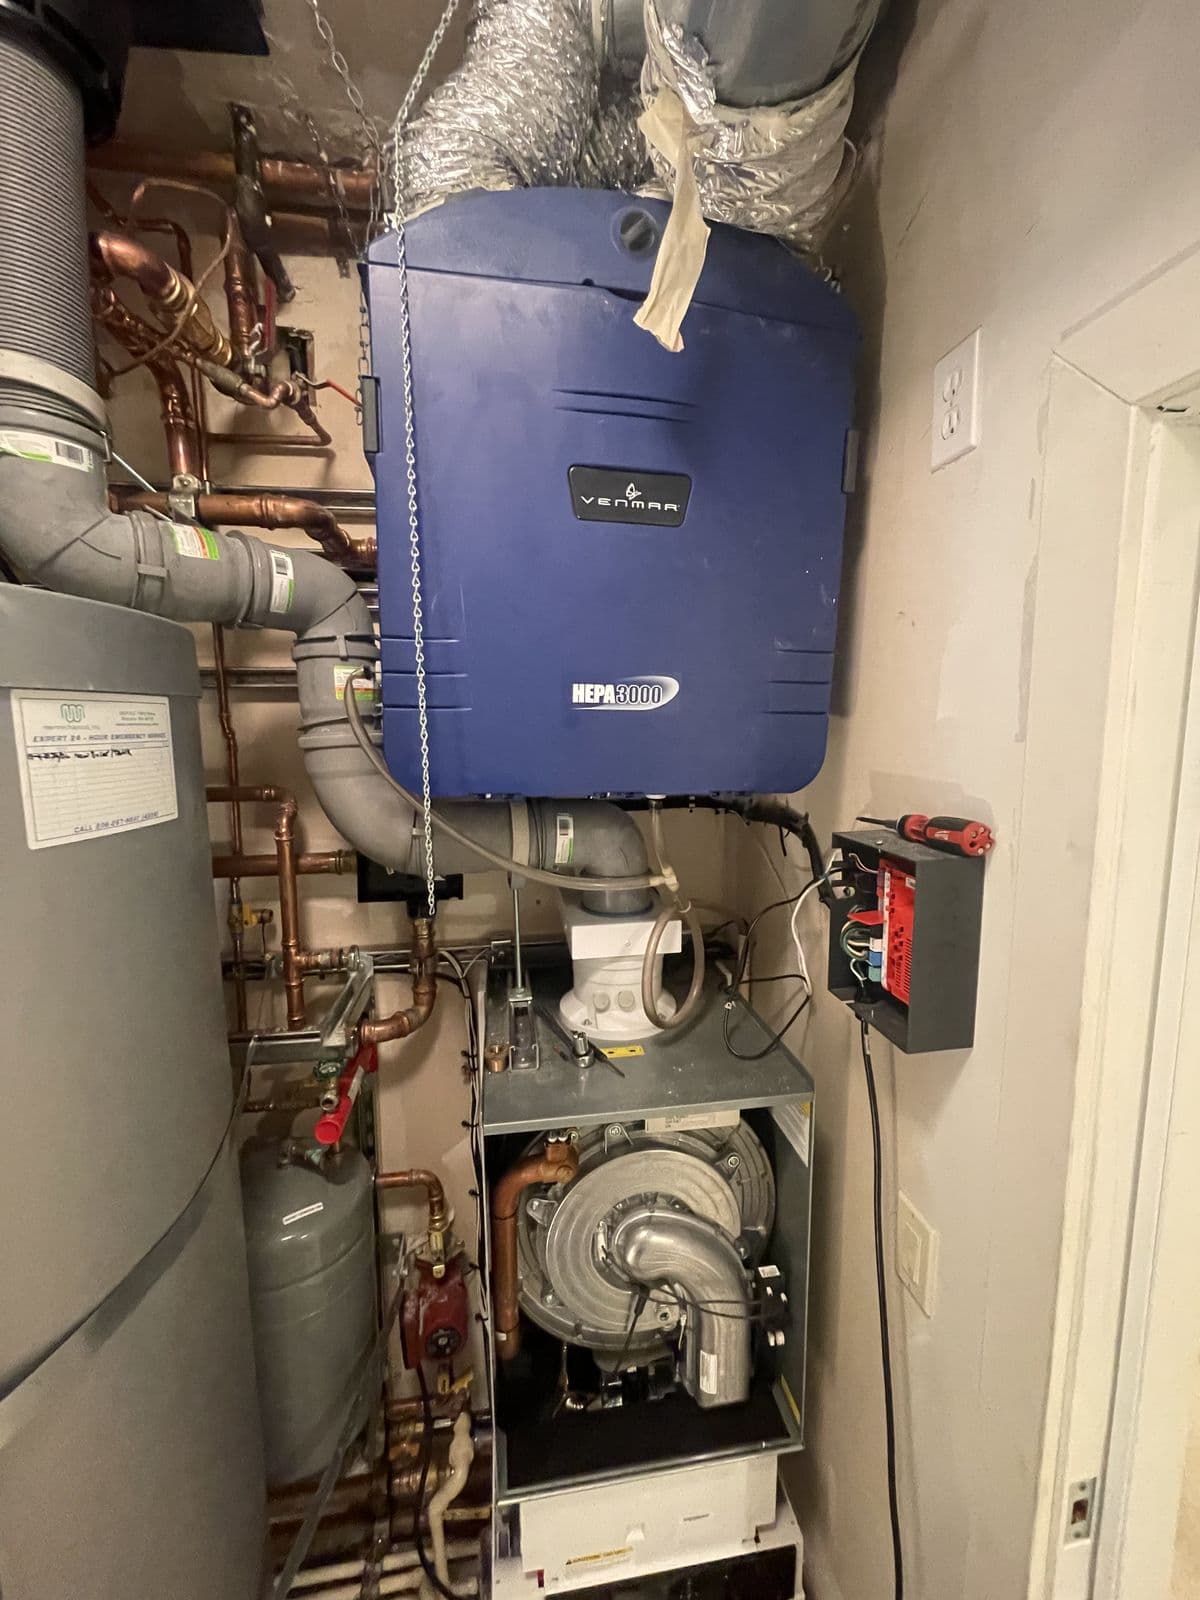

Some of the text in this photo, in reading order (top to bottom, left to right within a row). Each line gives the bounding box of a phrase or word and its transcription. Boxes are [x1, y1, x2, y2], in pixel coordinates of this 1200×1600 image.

[581, 496, 678, 511] VENMAR
[572, 683, 662, 704] HEPA3000
[74, 824, 92, 833] CALL
